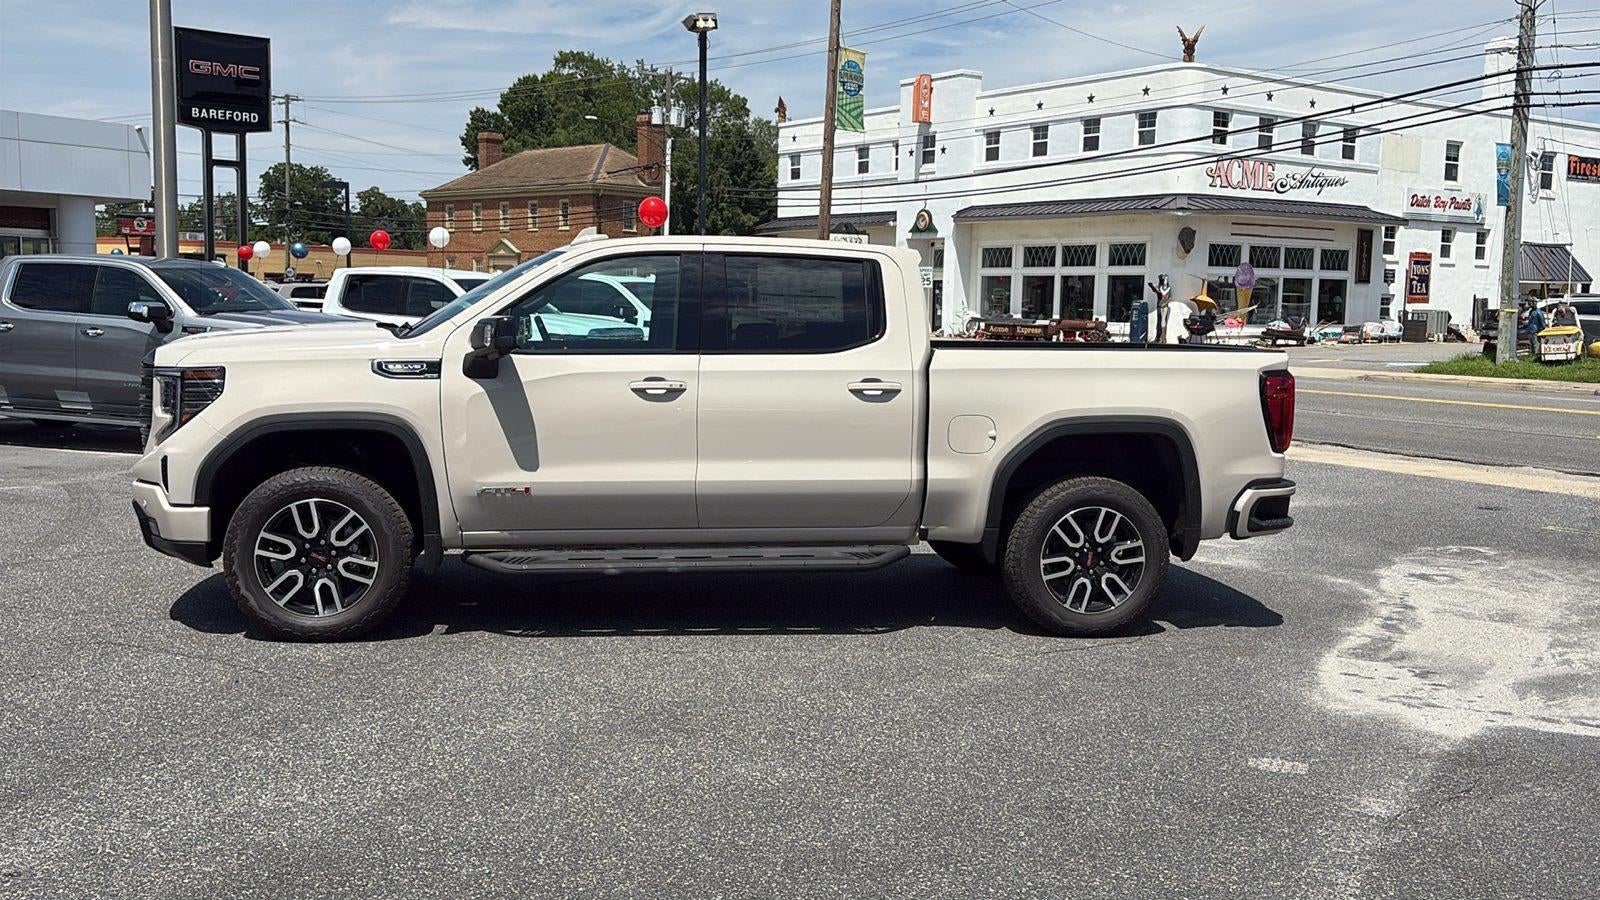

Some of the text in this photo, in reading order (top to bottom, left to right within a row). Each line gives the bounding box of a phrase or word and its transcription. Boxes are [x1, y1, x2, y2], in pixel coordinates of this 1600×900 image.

[188, 60, 260, 80] GMC
[191, 107, 259, 123] BAREFORD
[1206, 157, 1275, 192] ACME
[1287, 165, 1349, 196] Antiques
[1410, 193, 1472, 212] Dutch Boy Paints
[921, 277, 932, 286] 25
[1411, 280, 1427, 293] TEA
[989, 325, 1042, 334] Acme Express
